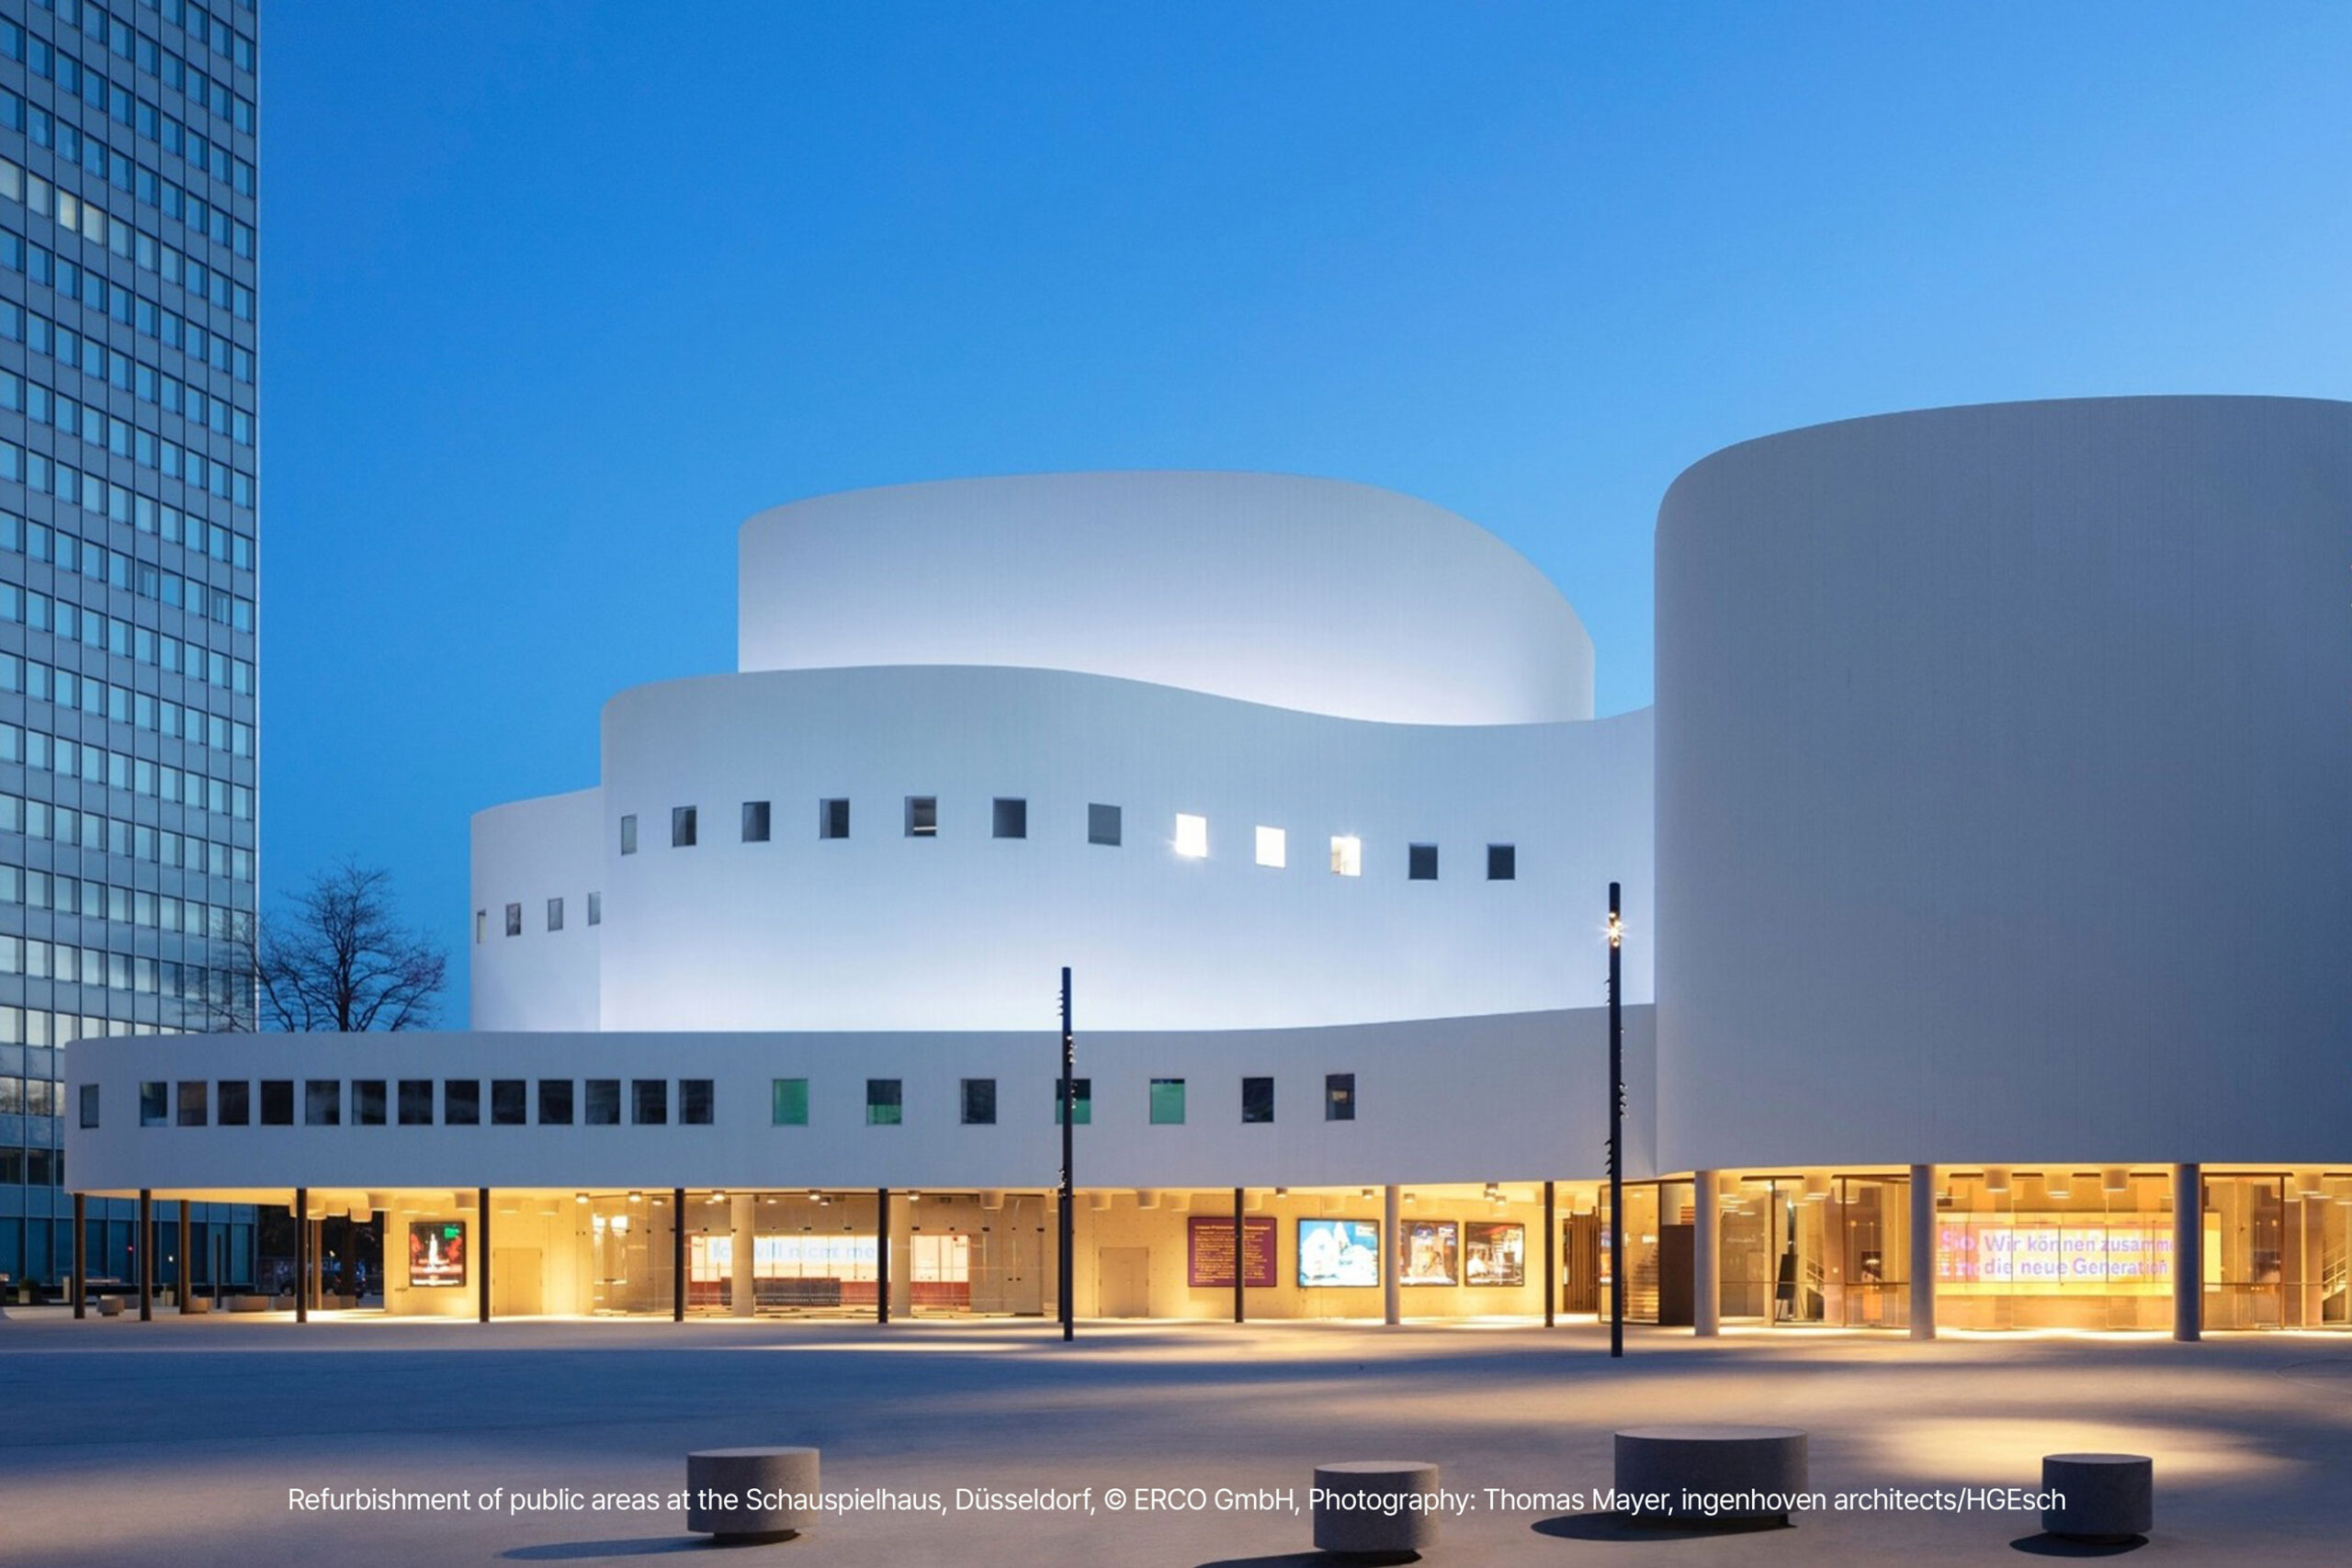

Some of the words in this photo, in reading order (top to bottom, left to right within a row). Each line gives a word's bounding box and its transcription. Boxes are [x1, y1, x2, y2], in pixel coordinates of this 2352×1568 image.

[1984, 1235, 2022, 1251] Wir
[2027, 1235, 2096, 1251] können
[1984, 1258, 2013, 1275] die
[2020, 1261, 2068, 1275] neue
[2072, 1257, 2168, 1275] Generation
